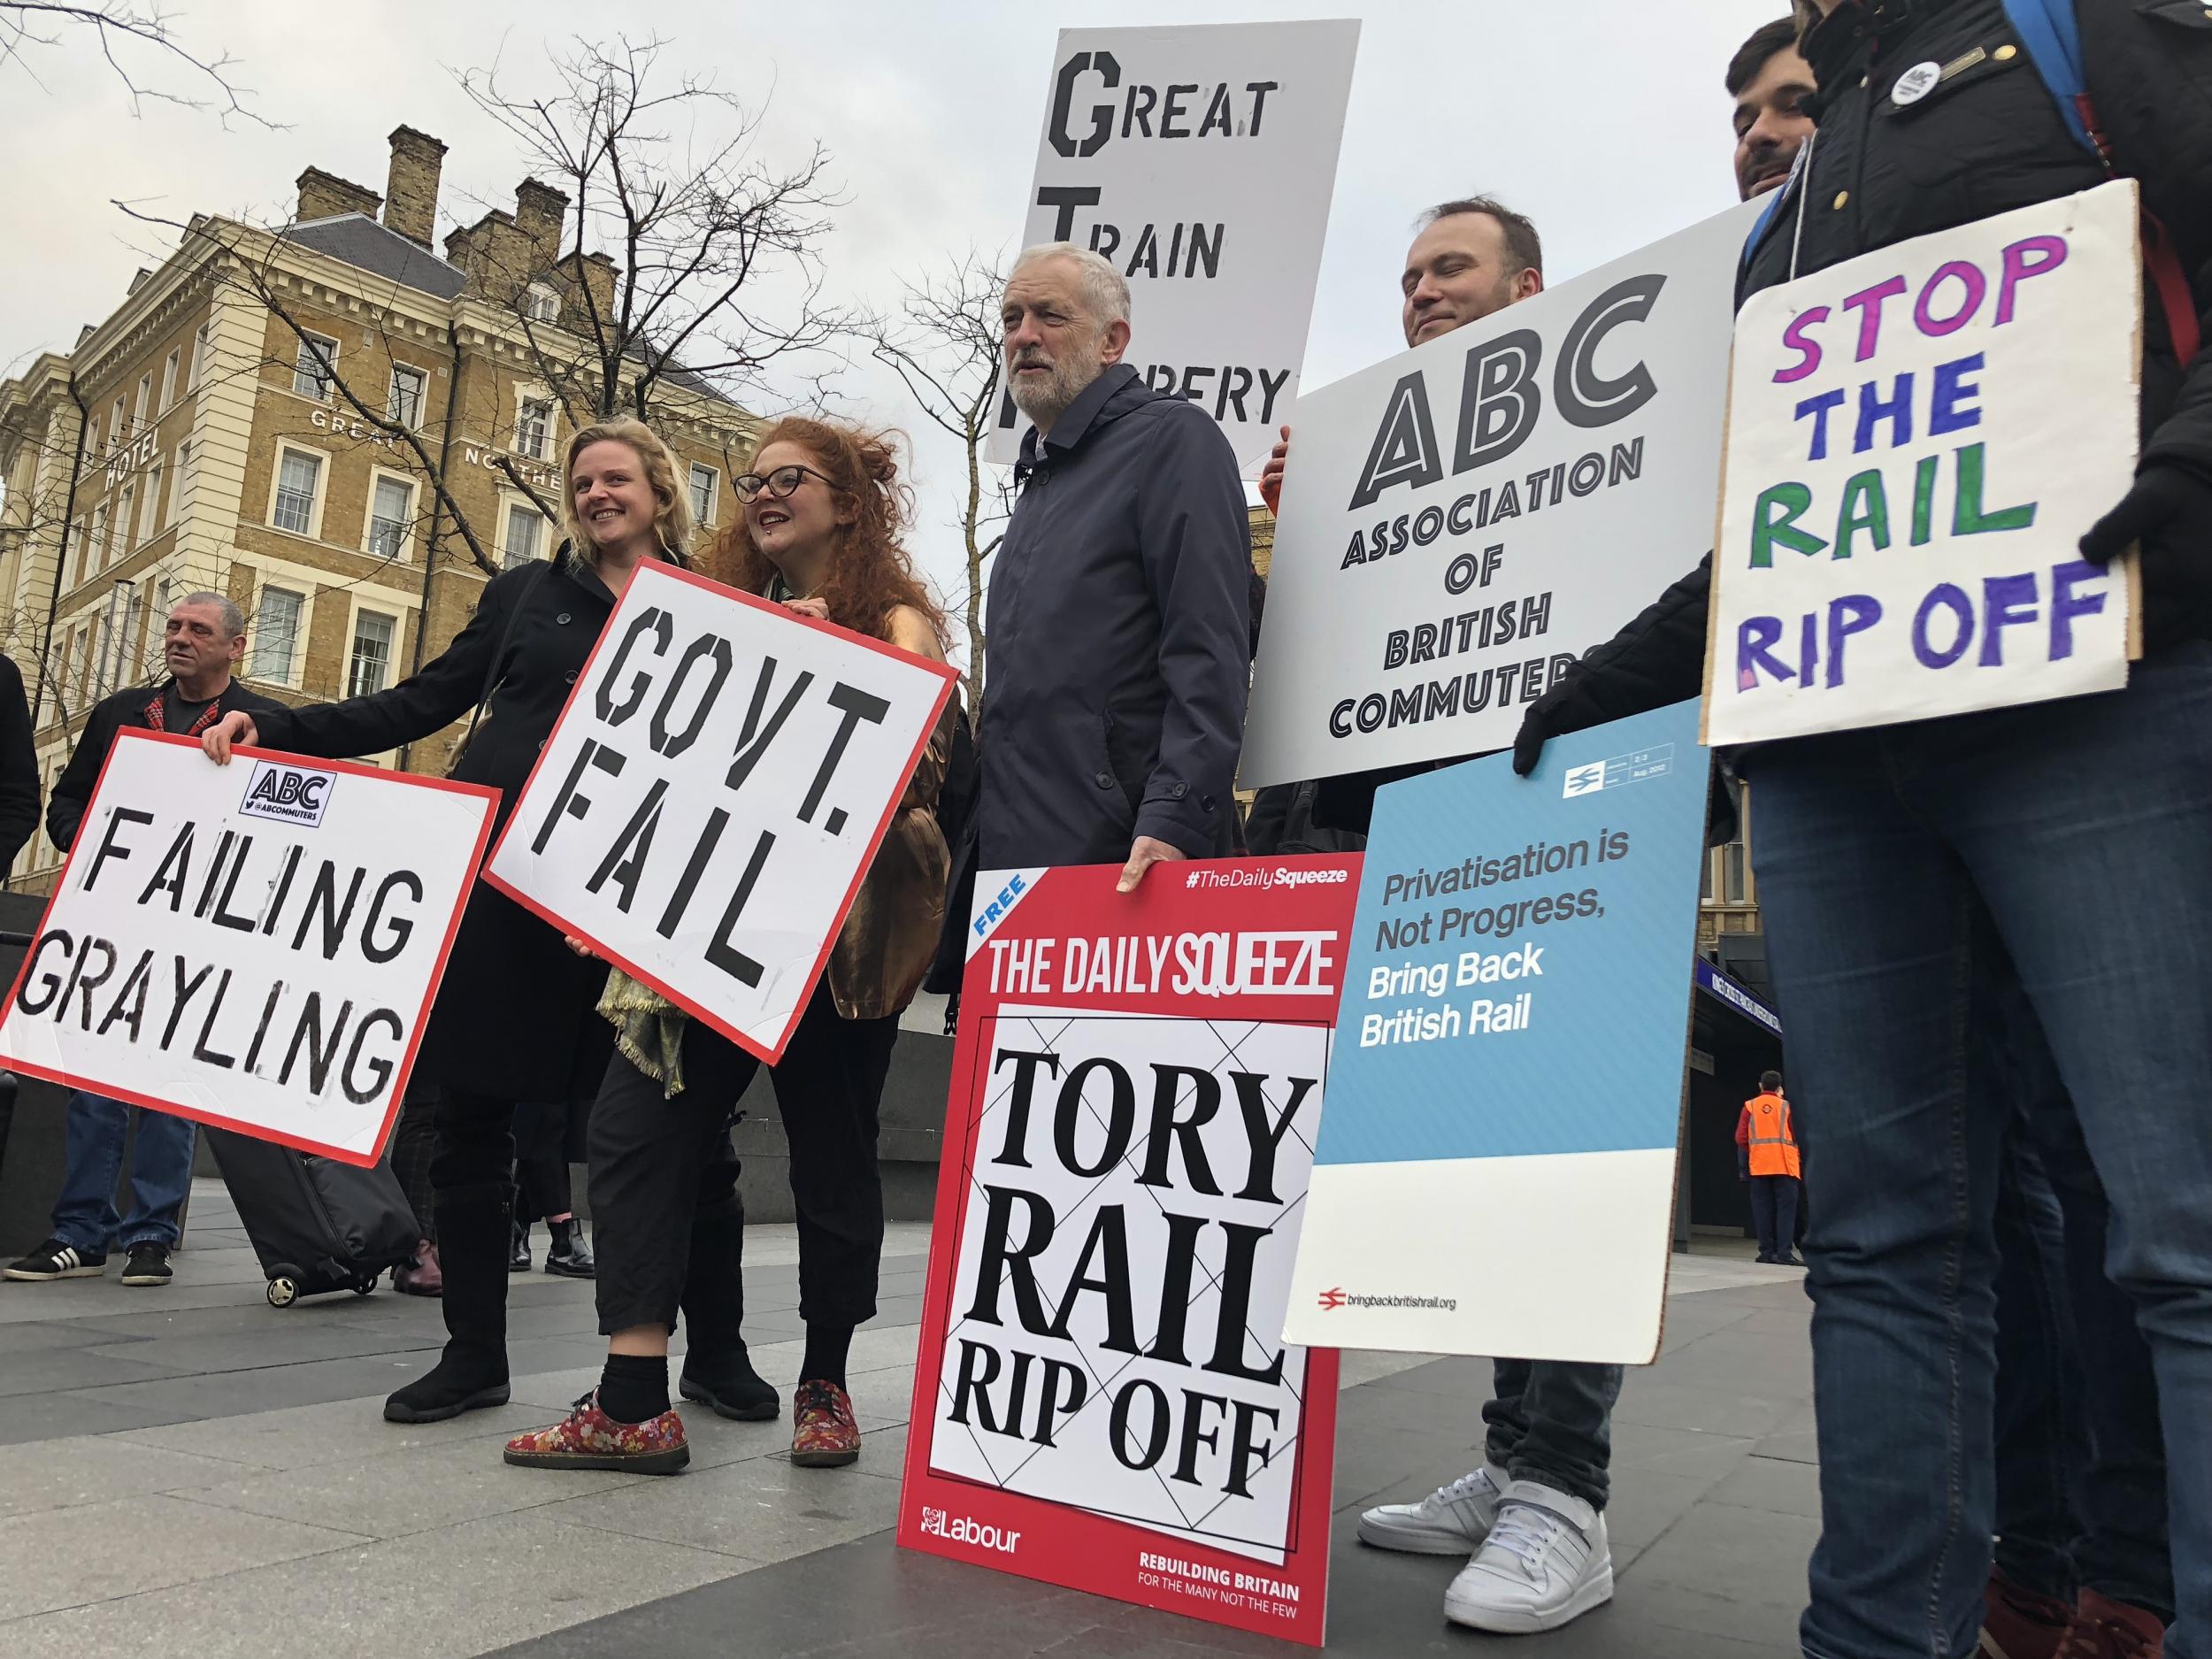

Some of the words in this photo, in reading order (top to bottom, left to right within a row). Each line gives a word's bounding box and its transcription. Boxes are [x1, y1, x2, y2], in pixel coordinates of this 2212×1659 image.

[1048, 51, 1279, 157] GREAT
[1037, 187, 1225, 279] TRAIN
[1771, 235, 2068, 383] STOP
[1348, 274, 1667, 511] ABC
[1793, 351, 1985, 461] THE
[104, 427, 159, 492] HOTEL
[1340, 436, 1644, 570] ASSOCIATION
[1748, 442, 2037, 569] RAIL
[1444, 543, 1504, 595] OF
[1384, 591, 1552, 670] BRITISH
[1737, 595, 1883, 693] RIP
[1912, 559, 2109, 670] OFF
[595, 606, 891, 836] GOVT.
[1329, 644, 1603, 738] COMMUTER
[250, 768, 328, 810] ABC
[255, 803, 318, 820] @ABCOMMUTERS
[82, 806, 423, 964] FAILING
[531, 738, 777, 989] FAIL
[973, 873, 1026, 937] FREE
[1186, 867, 1348, 890] #TheDailySqueeze
[1382, 840, 1589, 906] Privatisation
[1597, 828, 1629, 863] is
[1375, 912, 1432, 952] Not
[1439, 887, 1605, 941] Progress,
[988, 938, 1056, 994] THE
[1062, 934, 1173, 994] DAILY
[1171, 930, 1338, 998] SQUEEZE
[1367, 961, 1449, 999] Bring
[1455, 941, 1545, 987] Back
[16, 929, 403, 1105] GRAYLING
[1360, 1003, 1460, 1048] British
[1468, 993, 1532, 1035] Rail
[993, 1048, 1318, 1206] TORY
[963, 1184, 1285, 1387] RAIL
[1348, 1294, 1456, 1311] bringbackbritishrail.org
[946, 1337, 1087, 1448] RIP
[1109, 1379, 1280, 1500] OFF
[940, 1509, 1021, 1554] Labour
[1138, 1571, 1160, 1587] FOR
[1162, 1577, 1183, 1594] THE
[1185, 1582, 1218, 1601] MANY
[1219, 1590, 1246, 1607] NOT
[1246, 1596, 1270, 1613] THE
[1272, 1603, 1298, 1619] FEW
[1139, 1550, 1230, 1586] REBUILDING
[1234, 1572, 1300, 1602] BRITAIN
